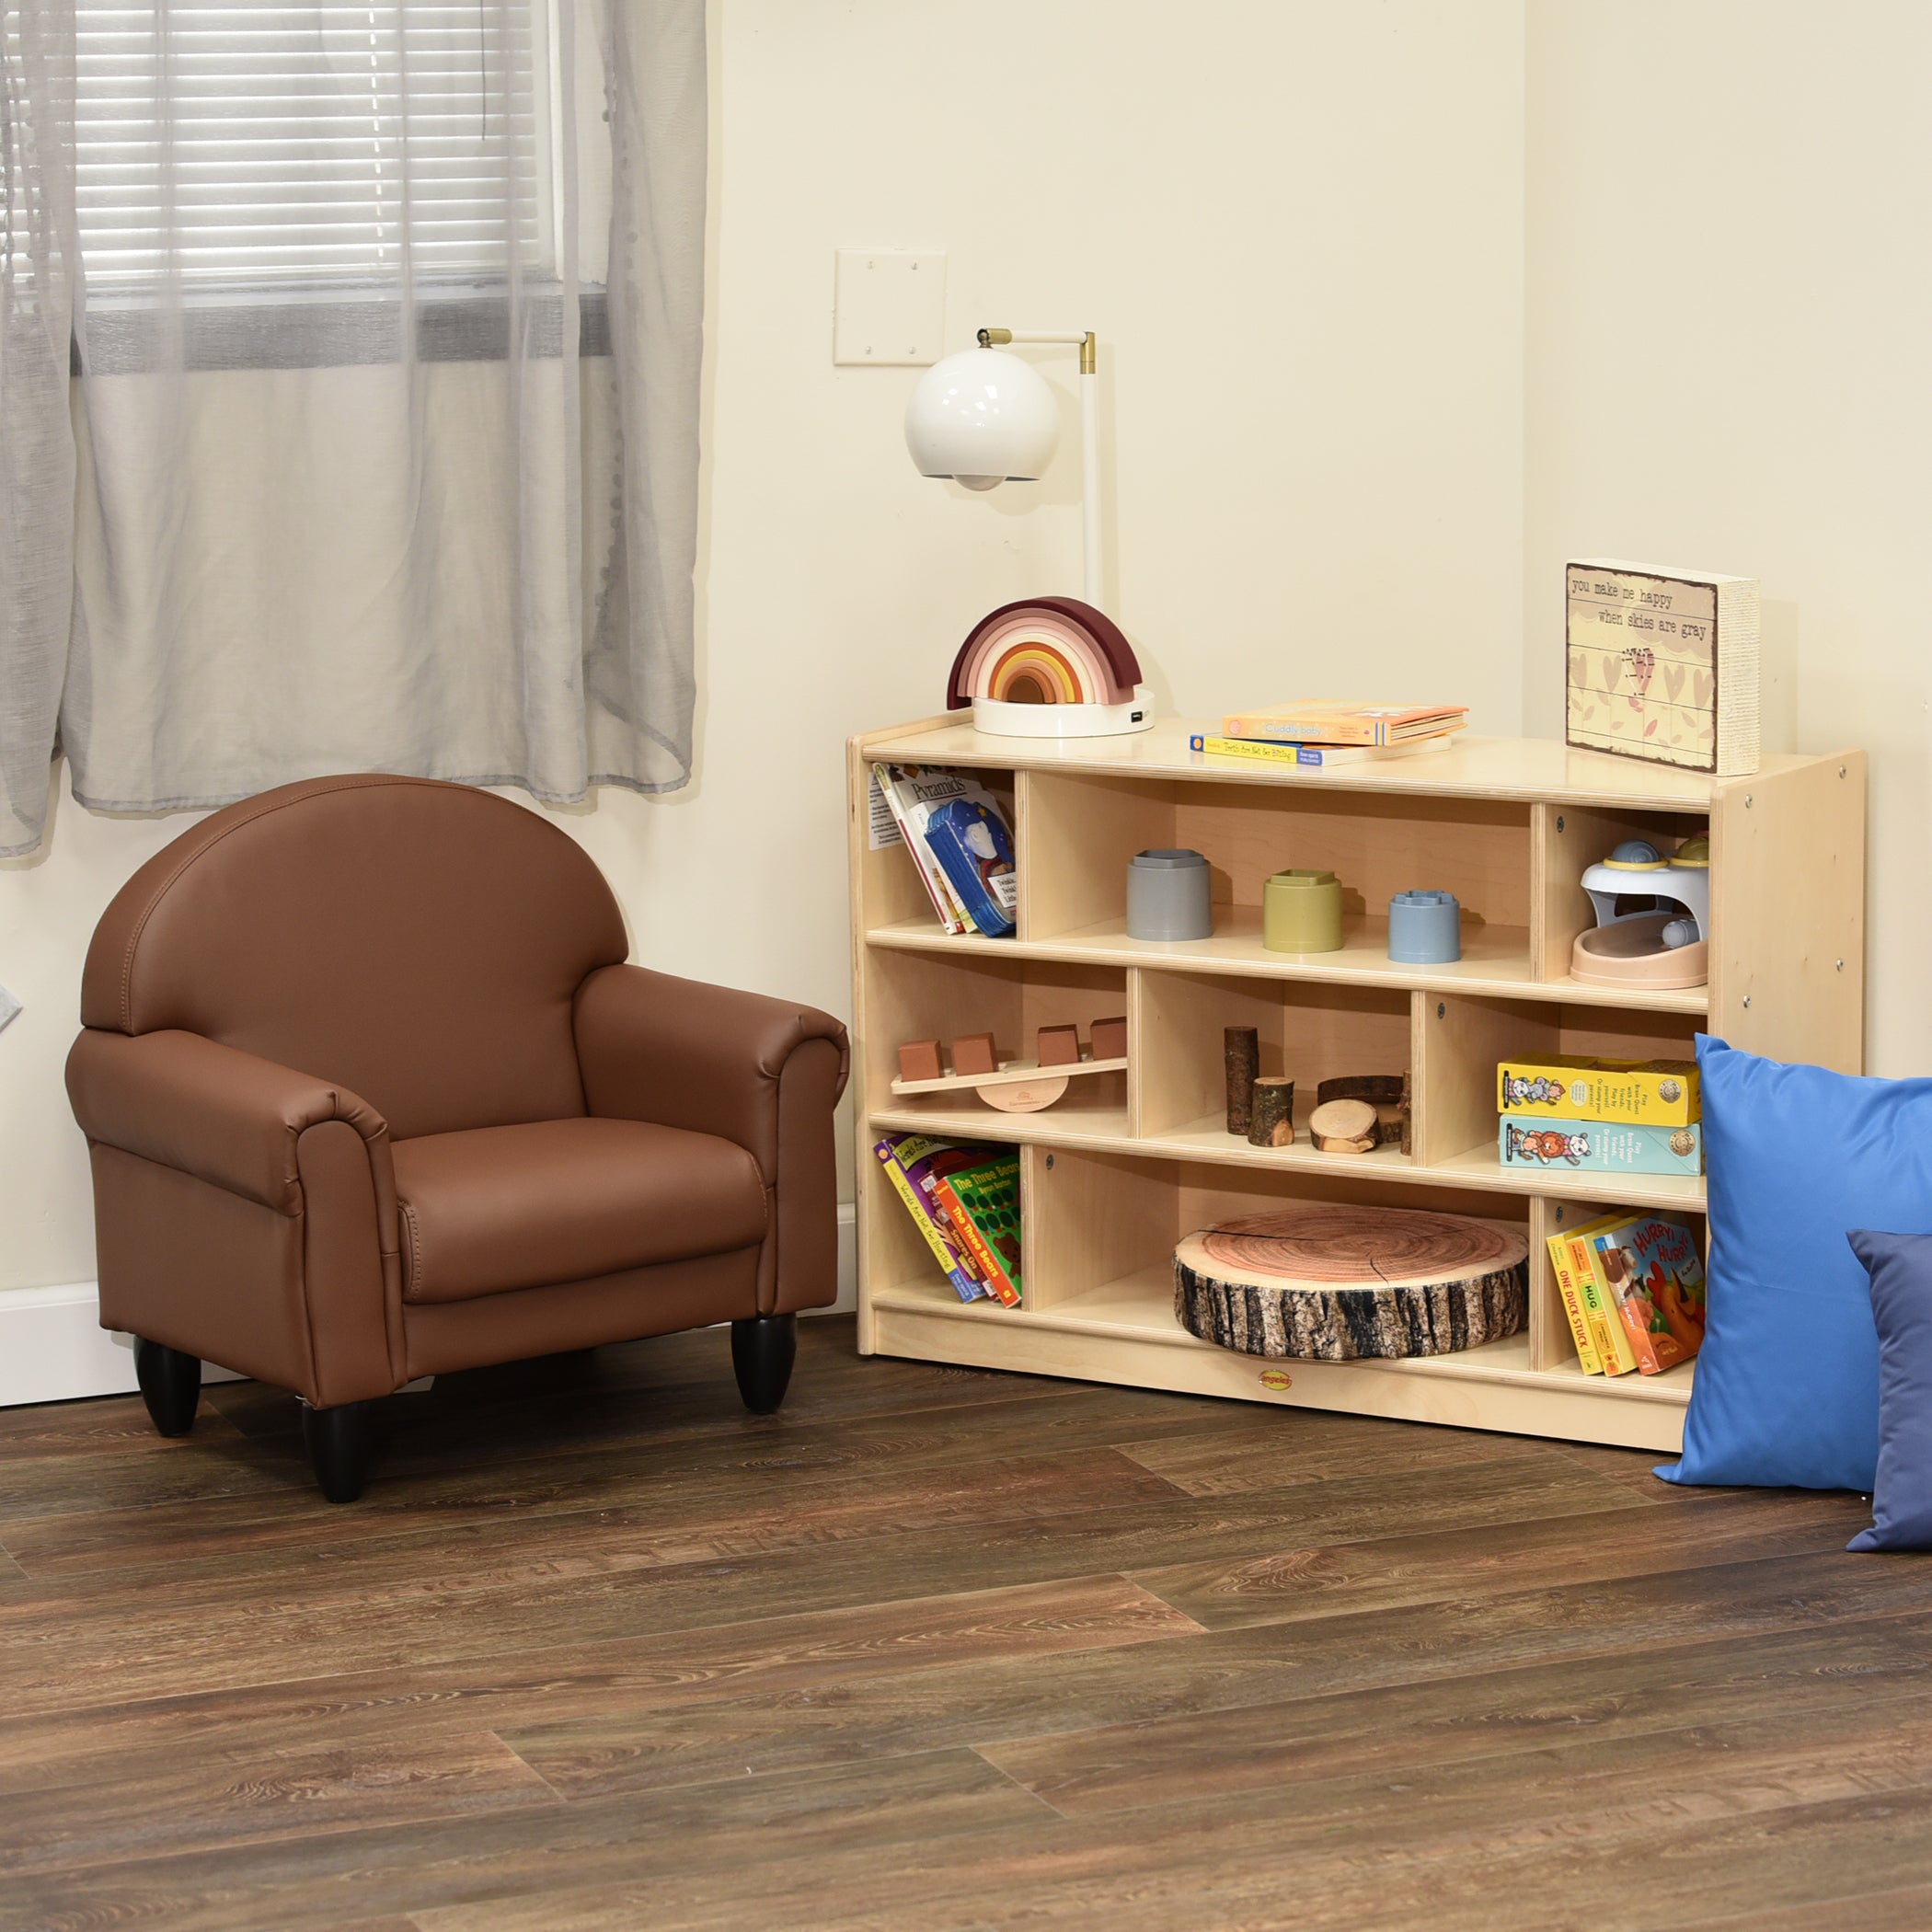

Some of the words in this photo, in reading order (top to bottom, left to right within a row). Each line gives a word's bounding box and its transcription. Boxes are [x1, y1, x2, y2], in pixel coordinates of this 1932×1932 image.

[1571, 579, 1590, 593] you
[1594, 582, 1618, 597] make
[1623, 589, 1635, 598] me
[1639, 589, 1673, 610] happy
[1598, 609, 1623, 626] when
[1628, 613, 1654, 630] skies
[1659, 621, 1677, 633] are
[1681, 624, 1707, 641] gray
[1265, 722, 1298, 735] Cuddly
[1301, 725, 1321, 736] baby
[911, 775, 966, 800] Pyramids
[953, 1179, 973, 1191] The
[971, 1170, 997, 1185] Three
[933, 1240, 951, 1269] Hurting
[950, 1228, 970, 1257] Snores
[967, 1256, 978, 1270] On
[952, 1205, 966, 1225] The
[963, 1223, 982, 1250] Three
[979, 1249, 999, 1278] Bears
[1632, 1223, 1675, 1258] HURRY!
[1559, 1271, 1572, 1290] ONE
[1565, 1291, 1579, 1317] DUCK
[1584, 1285, 1597, 1308] HUG
[1572, 1318, 1588, 1348] STUCK
